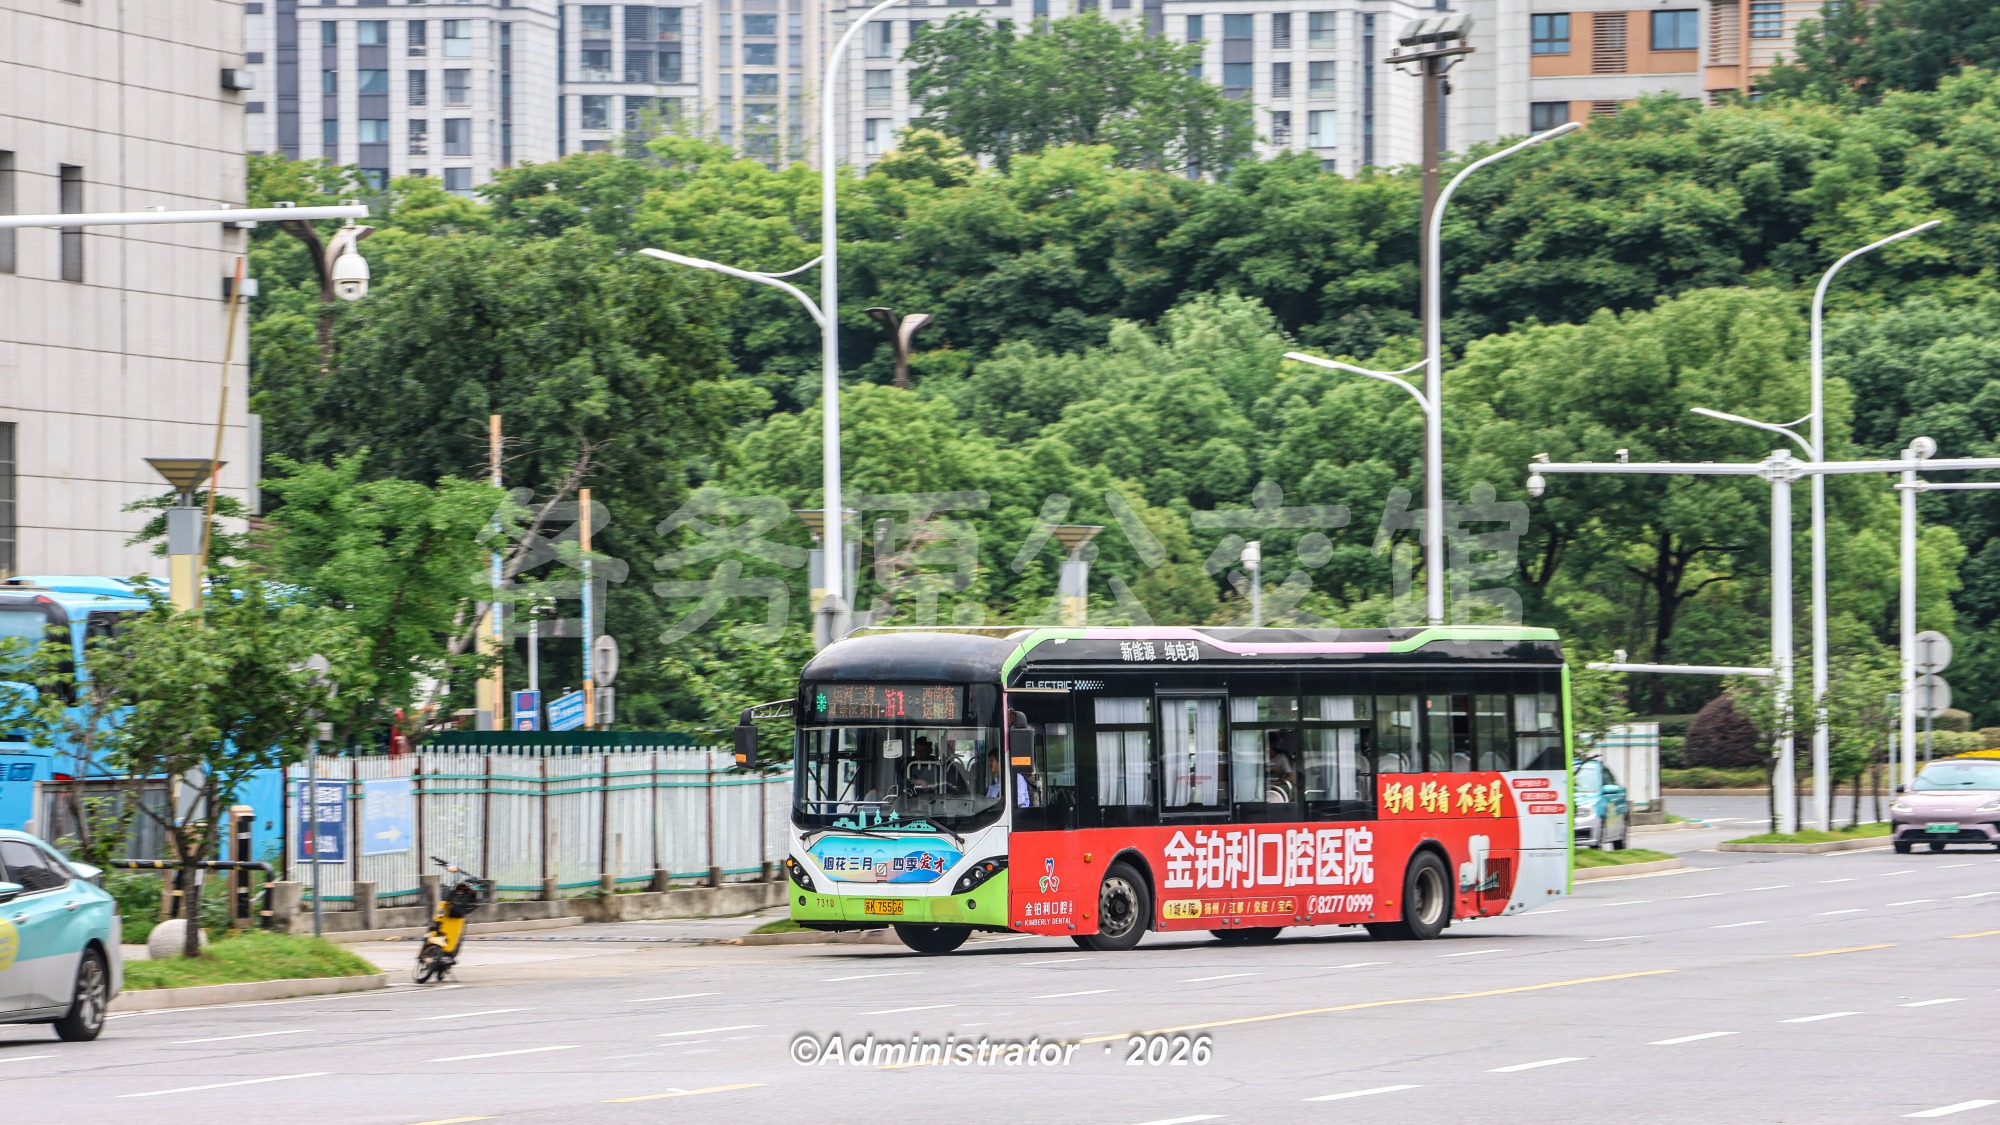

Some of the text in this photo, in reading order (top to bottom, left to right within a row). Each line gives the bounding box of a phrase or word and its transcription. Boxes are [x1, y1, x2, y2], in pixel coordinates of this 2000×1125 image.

[1120, 641, 1199, 661] 新能源 纯电动
[1025, 680, 1072, 690] ELECTRIC
[1382, 779, 1503, 818] 好用 好看 不塞牙
[823, 852, 946, 874] 烟花三月 四季爱才
[1164, 826, 1374, 889] 金铂利口腔医院
[816, 898, 835, 908] 7310
[1024, 901, 1068, 916] 金铂利口腔
[1204, 902, 1219, 915] 扬州
[1229, 901, 1244, 914] 江都
[1253, 901, 1269, 913] 仪征
[1318, 894, 1374, 914] 8277 0999
[1024, 917, 1071, 926] KIMBERLY DENTAL
